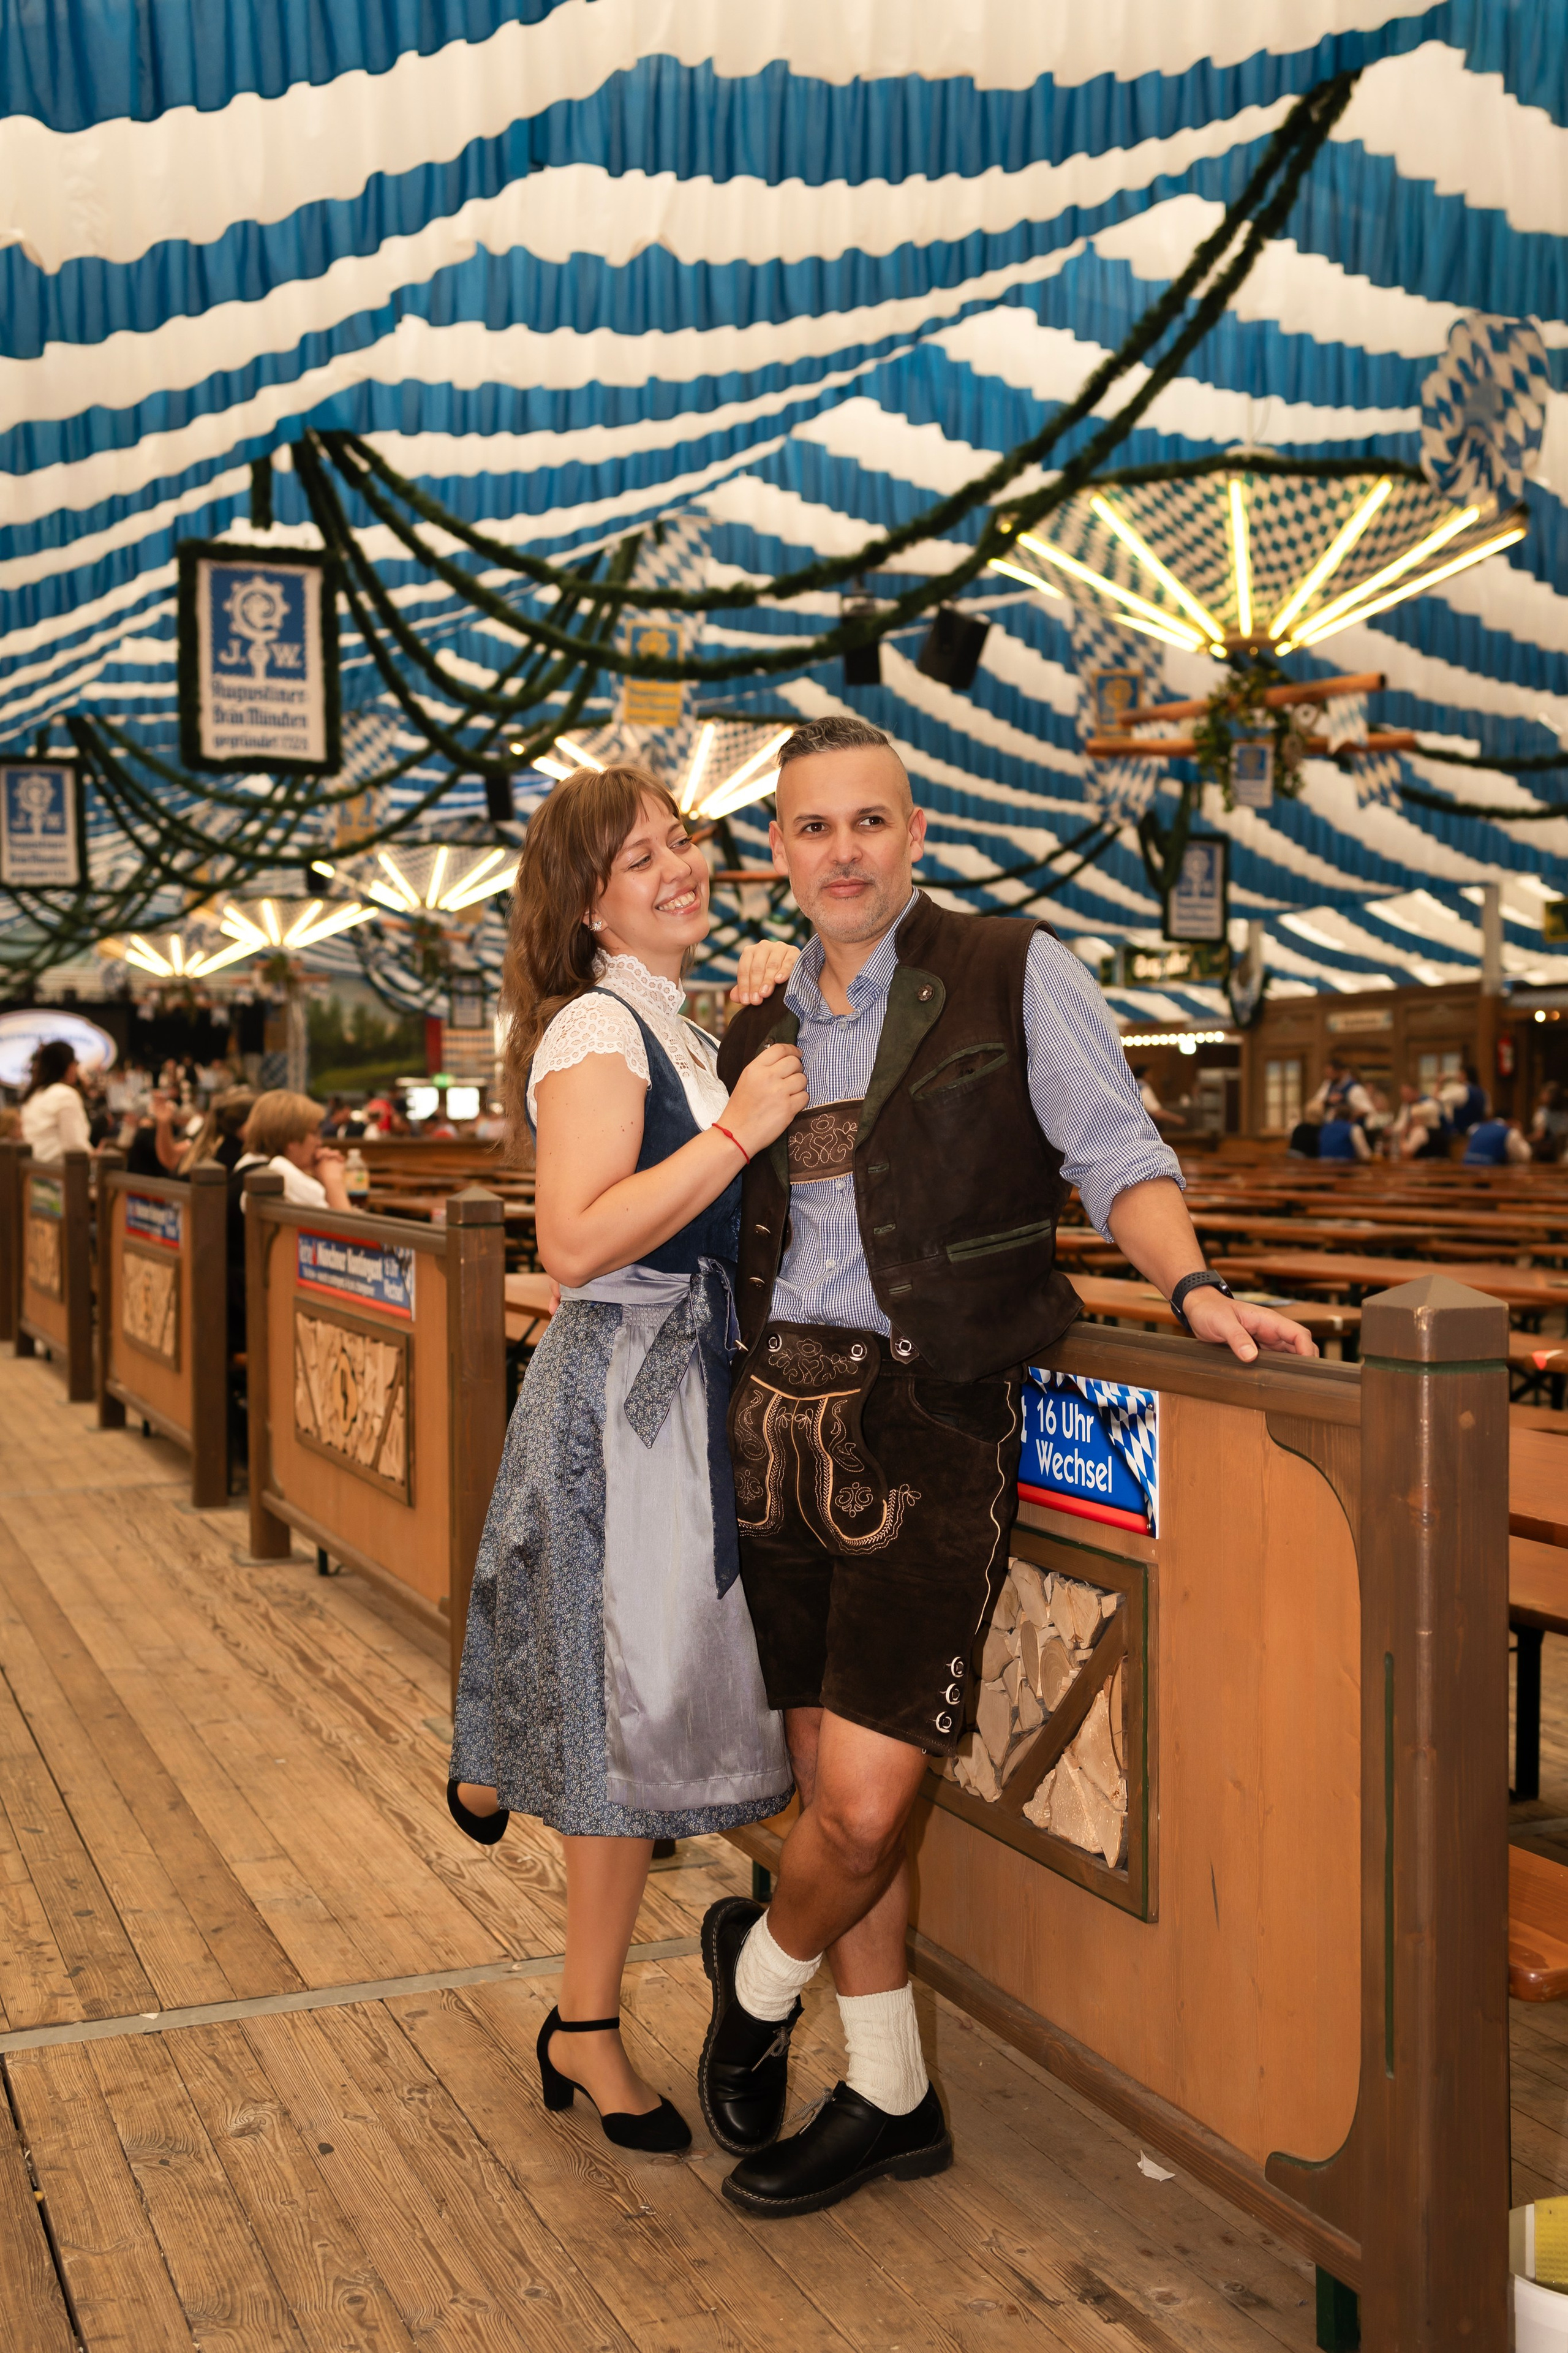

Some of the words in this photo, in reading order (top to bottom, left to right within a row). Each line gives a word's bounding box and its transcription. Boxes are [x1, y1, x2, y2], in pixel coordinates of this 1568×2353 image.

[1036, 1397, 1057, 1435] 16
[1061, 1401, 1095, 1443] Uhr
[1036, 1438, 1112, 1494] Wechsel
